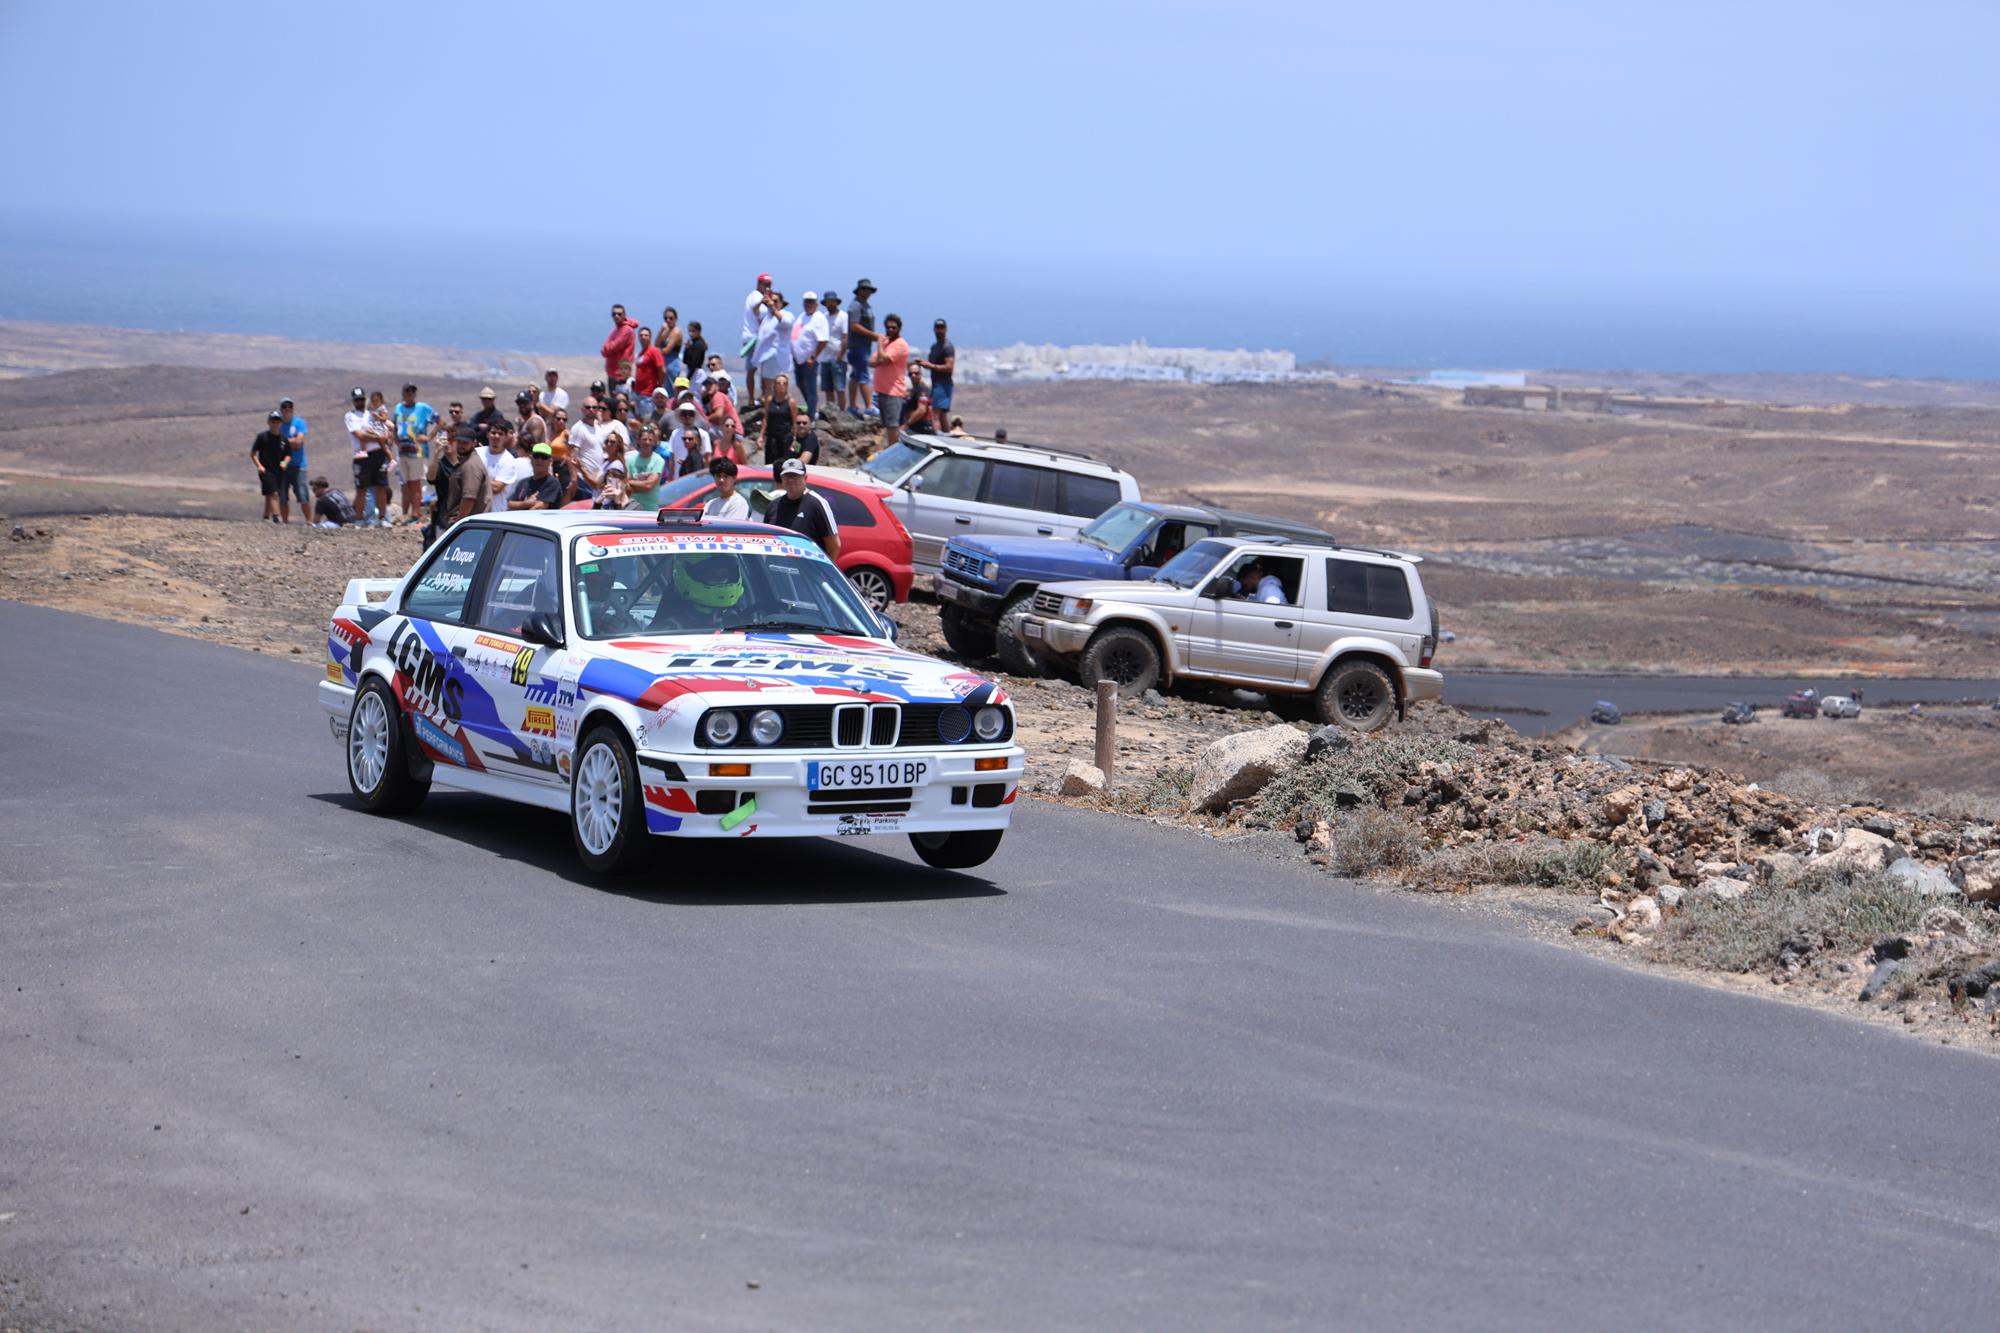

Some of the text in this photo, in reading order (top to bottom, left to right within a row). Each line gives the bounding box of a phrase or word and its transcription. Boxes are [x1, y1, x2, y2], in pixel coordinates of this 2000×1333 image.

[619, 536, 669, 544] COPA
[451, 547, 475, 565] Duque
[386, 618, 464, 724] LCMS
[513, 648, 534, 684] 19
[666, 658, 913, 681] LCMS
[821, 762, 927, 787] GC 9510 BP
